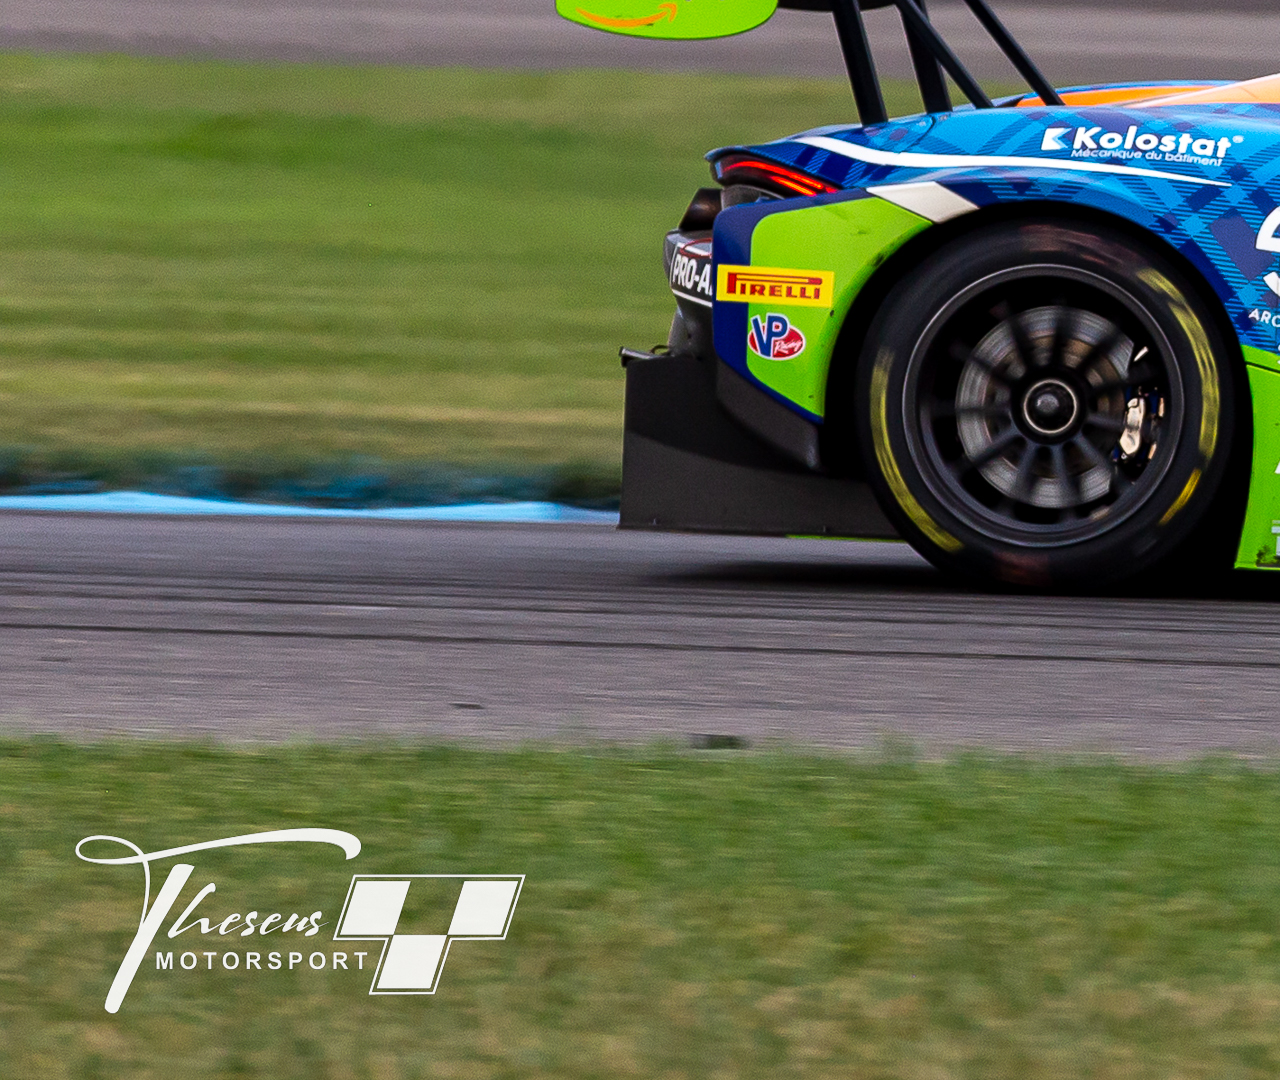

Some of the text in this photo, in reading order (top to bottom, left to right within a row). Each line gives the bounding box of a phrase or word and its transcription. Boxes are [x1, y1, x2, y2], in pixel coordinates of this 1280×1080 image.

[1073, 125, 1232, 159] Kolostat
[1145, 149, 1163, 161] du
[672, 253, 712, 297] PRO-A
[726, 271, 823, 300] PIRELLI
[750, 314, 789, 358] VP
